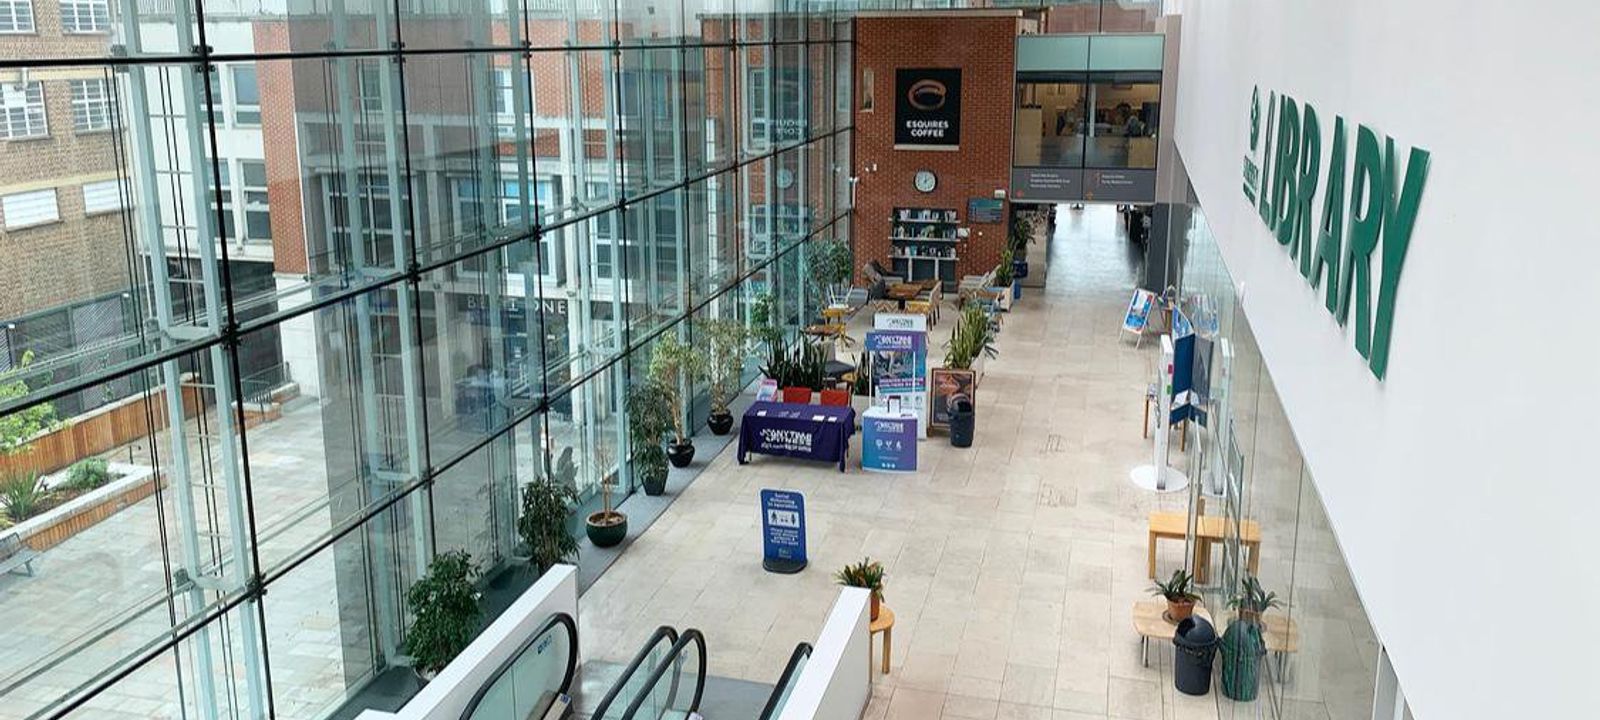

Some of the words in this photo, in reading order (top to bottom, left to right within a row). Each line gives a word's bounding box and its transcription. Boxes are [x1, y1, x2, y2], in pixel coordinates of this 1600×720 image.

[906, 120, 949, 129] ESQUIRES
[911, 128, 944, 137] COFFEE
[1259, 89, 1431, 382] LIBRARY
